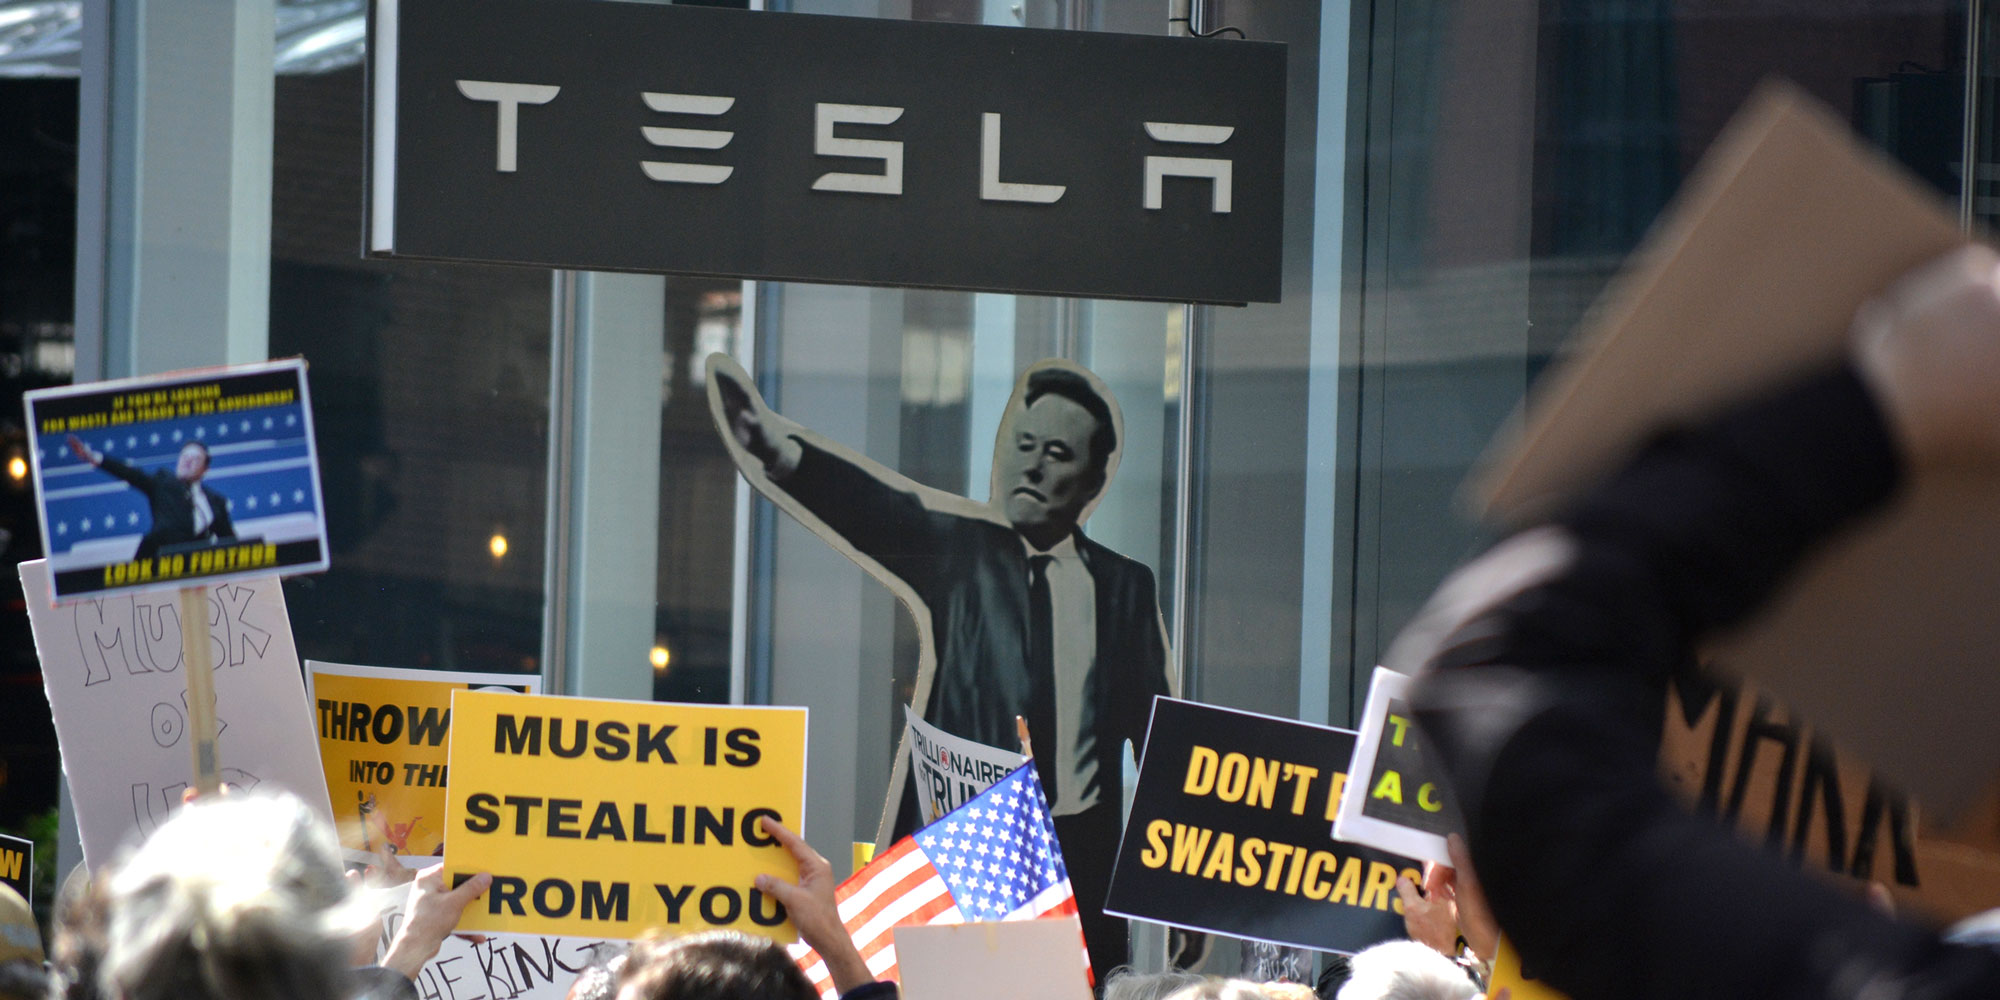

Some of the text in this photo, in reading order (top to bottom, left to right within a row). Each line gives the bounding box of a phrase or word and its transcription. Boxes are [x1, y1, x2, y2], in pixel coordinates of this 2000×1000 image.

[456, 79, 1236, 214] TESLA
[43, 418, 66, 434] FOR
[111, 408, 135, 426] AND
[218, 388, 294, 413] GOVERNMENT
[104, 557, 152, 587] LOOK
[158, 553, 184, 578] NO
[151, 688, 228, 748] O
[318, 699, 451, 746] THROW
[494, 713, 763, 768] MUSK IS
[350, 760, 395, 785] INTO
[1183, 745, 1318, 816] DON'T
[464, 792, 784, 848] STEALING
[654, 883, 788, 927] YOU
[1259, 952, 1300, 980] MUSK
